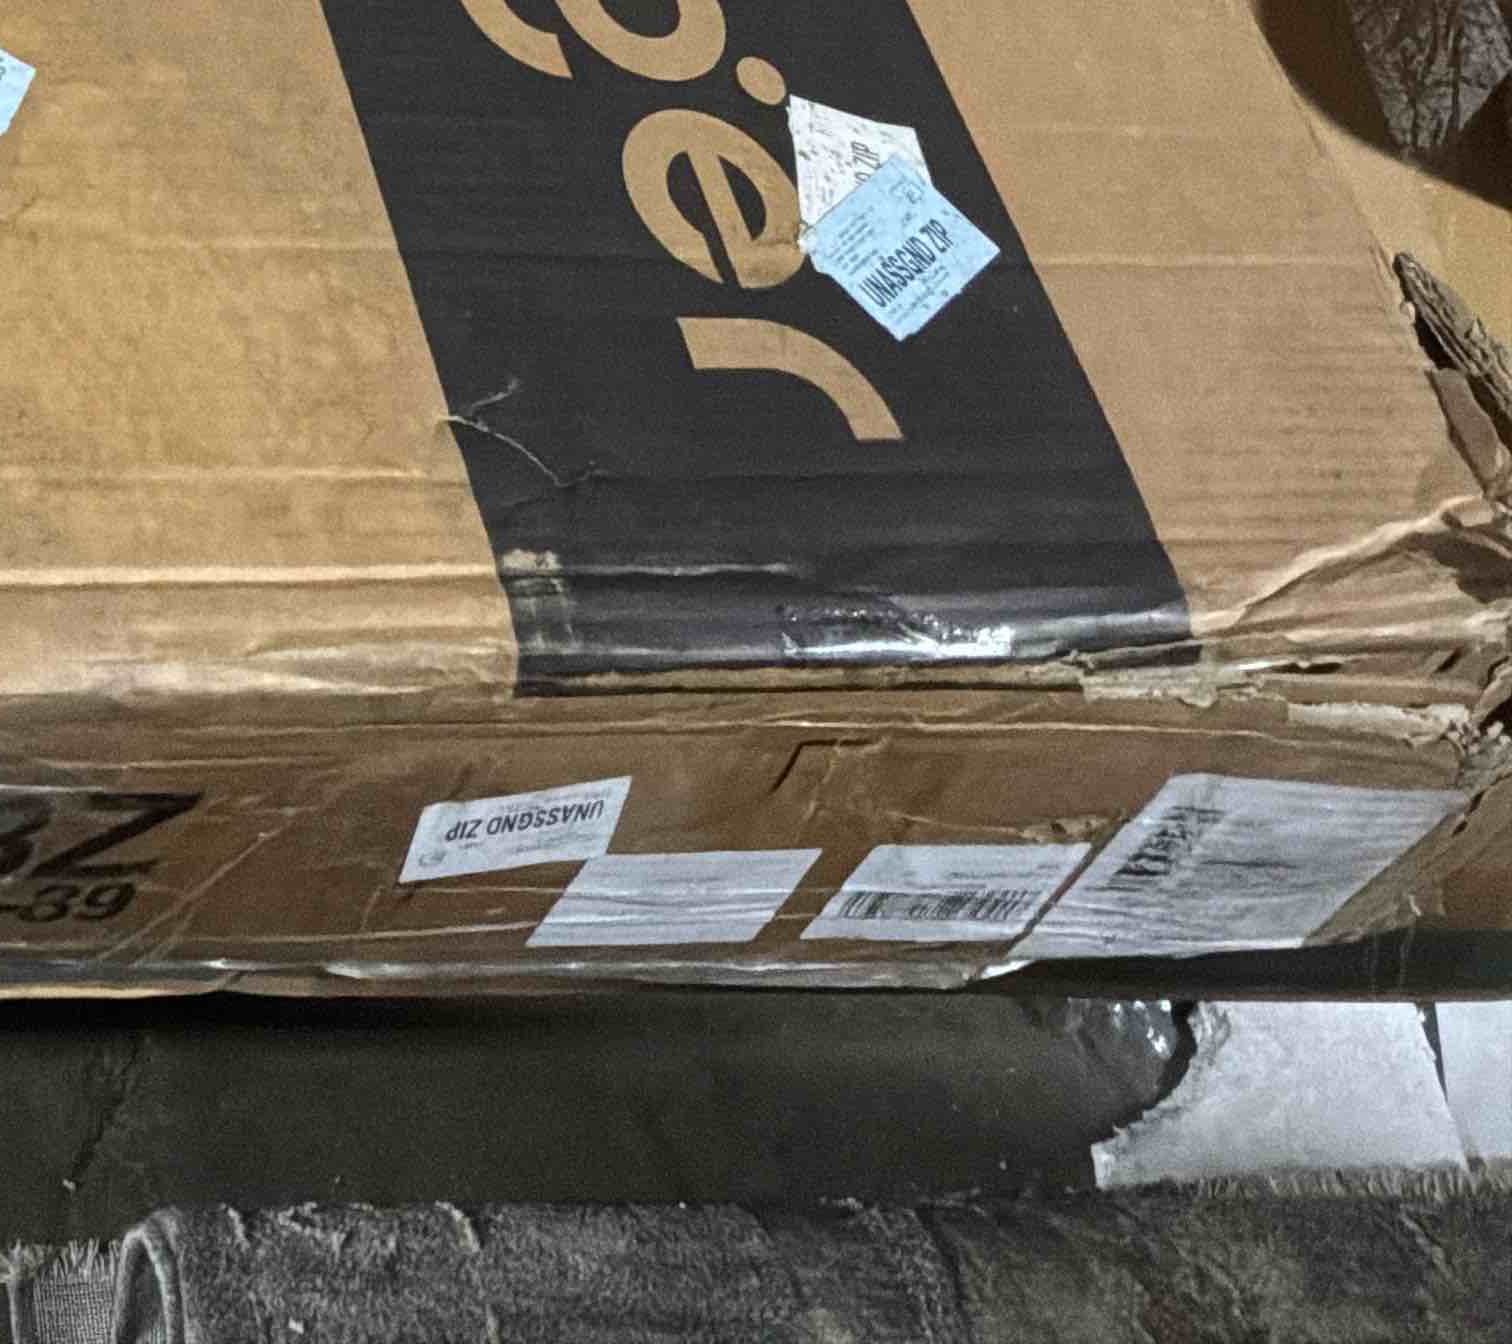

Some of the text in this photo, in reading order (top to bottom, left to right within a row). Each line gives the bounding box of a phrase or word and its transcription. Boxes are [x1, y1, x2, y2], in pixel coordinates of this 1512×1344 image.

[858, 236, 939, 309] UNASSGND
[919, 218, 955, 254] ZIP
[445, 798, 603, 842] UNASSGND ZIP
